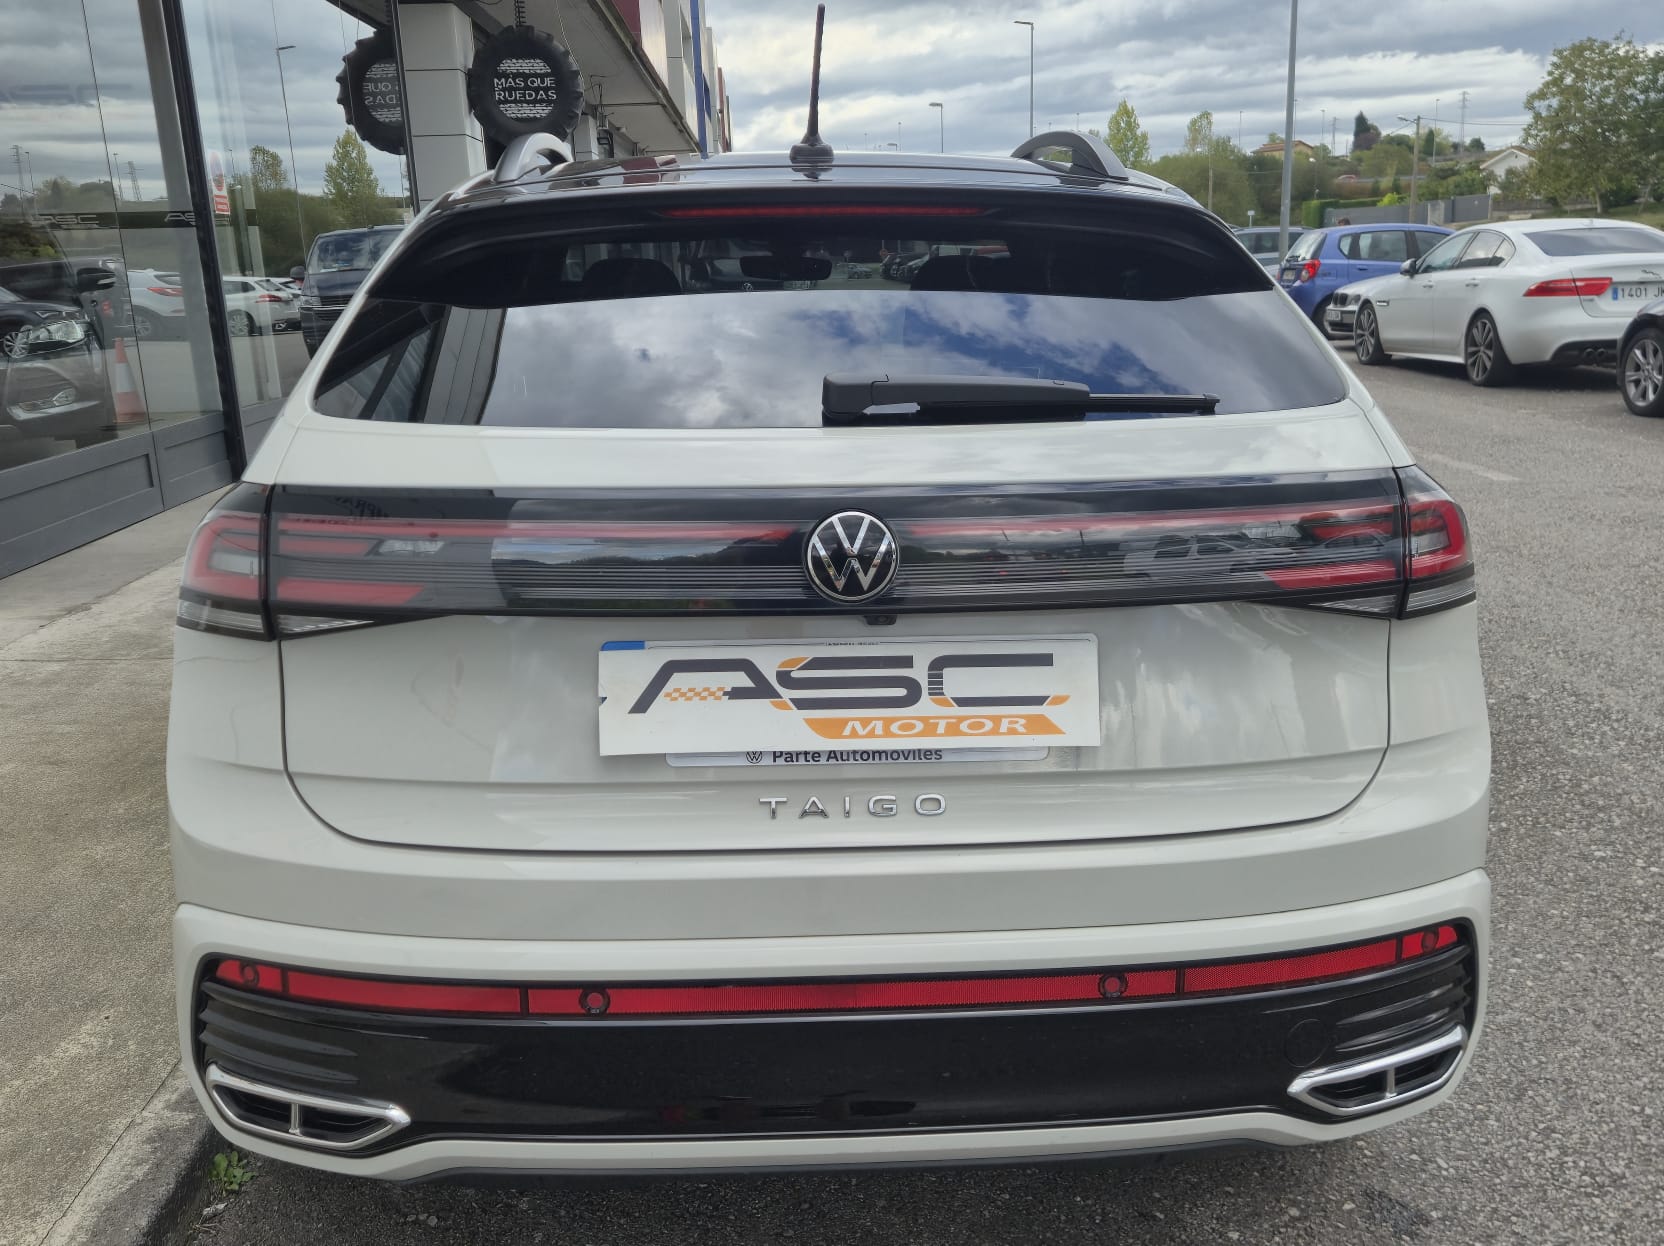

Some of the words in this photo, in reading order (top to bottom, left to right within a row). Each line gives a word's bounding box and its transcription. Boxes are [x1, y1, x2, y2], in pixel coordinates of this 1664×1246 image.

[493, 74, 525, 87] MÁS
[527, 77, 556, 87] QUE
[495, 90, 557, 100] RUEDAS
[1621, 287, 1647, 298] 1401
[628, 652, 1071, 714] ASC
[841, 717, 1028, 736] MOTOR
[772, 750, 822, 763] Parte
[759, 793, 946, 819] TAIGO
